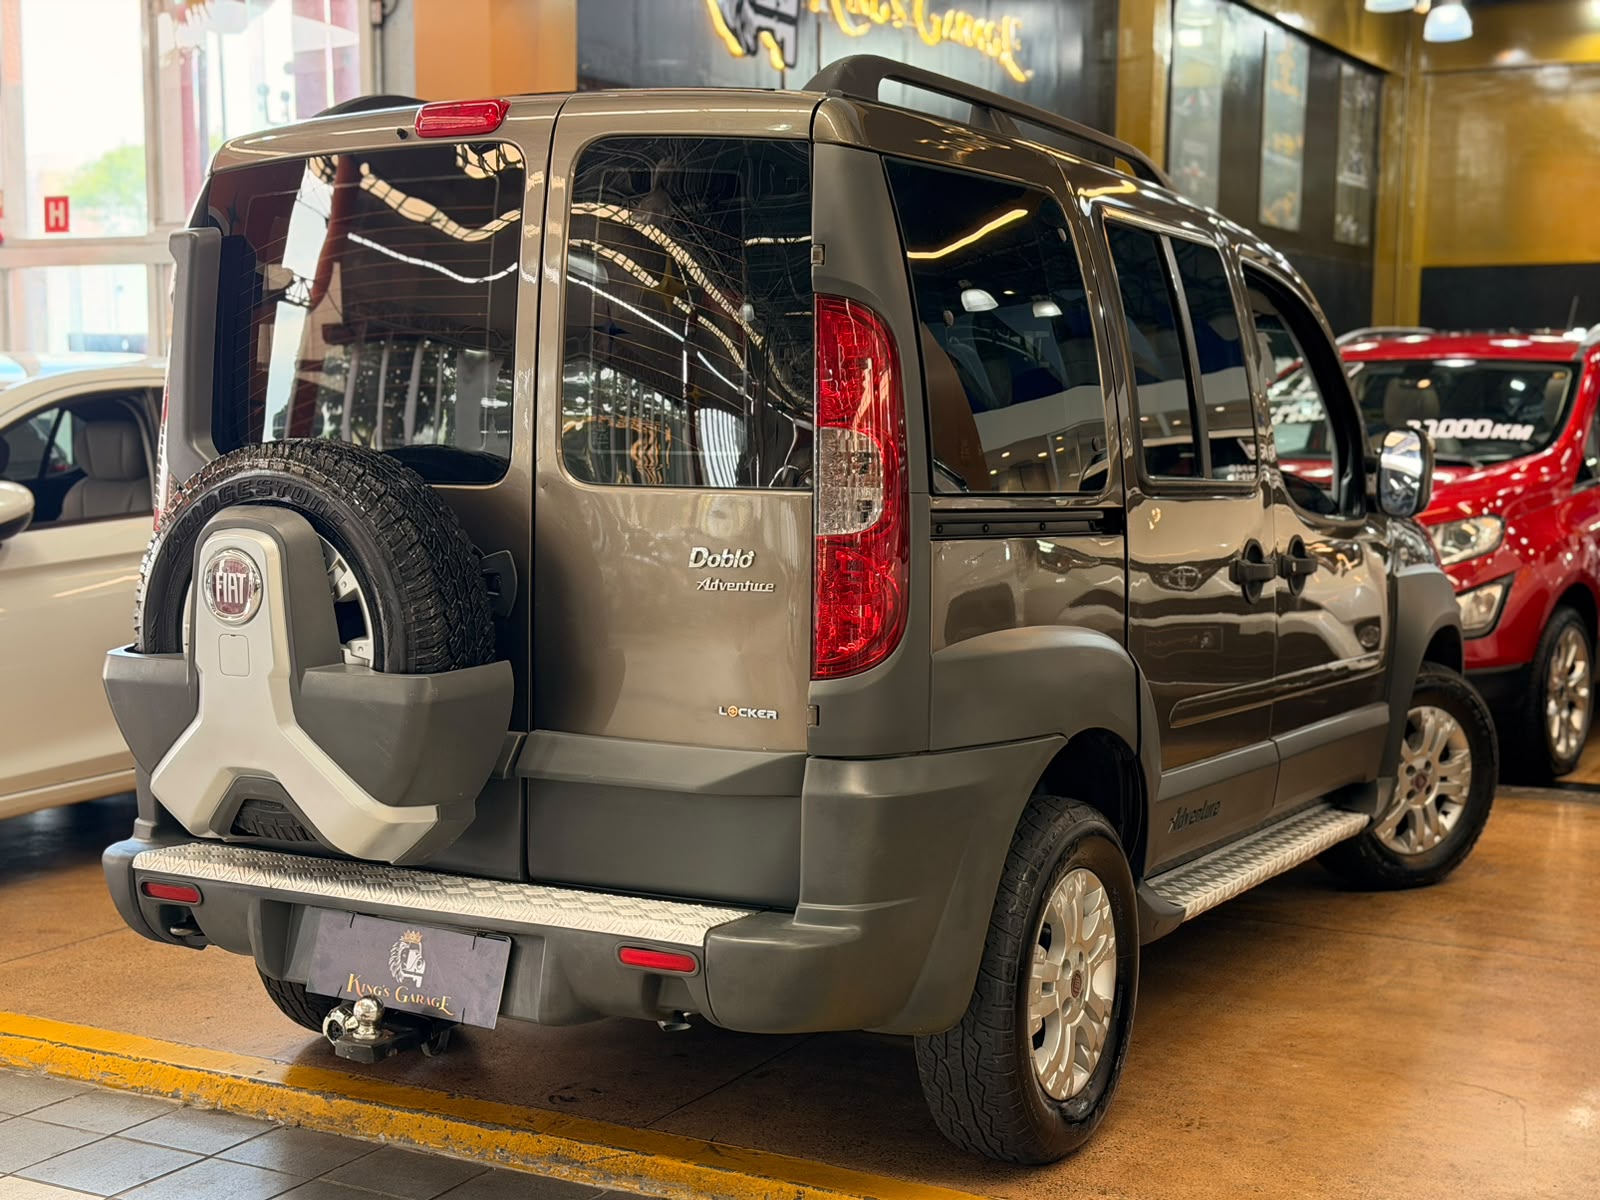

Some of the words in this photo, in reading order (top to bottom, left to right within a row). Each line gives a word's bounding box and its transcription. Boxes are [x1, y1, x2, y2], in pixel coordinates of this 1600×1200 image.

[48, 200, 66, 228] H
[215, 571, 247, 604] FIAT
[696, 576, 775, 593] Adventure
[718, 705, 778, 720] LOCKER
[394, 985, 455, 1016] GARAGE
